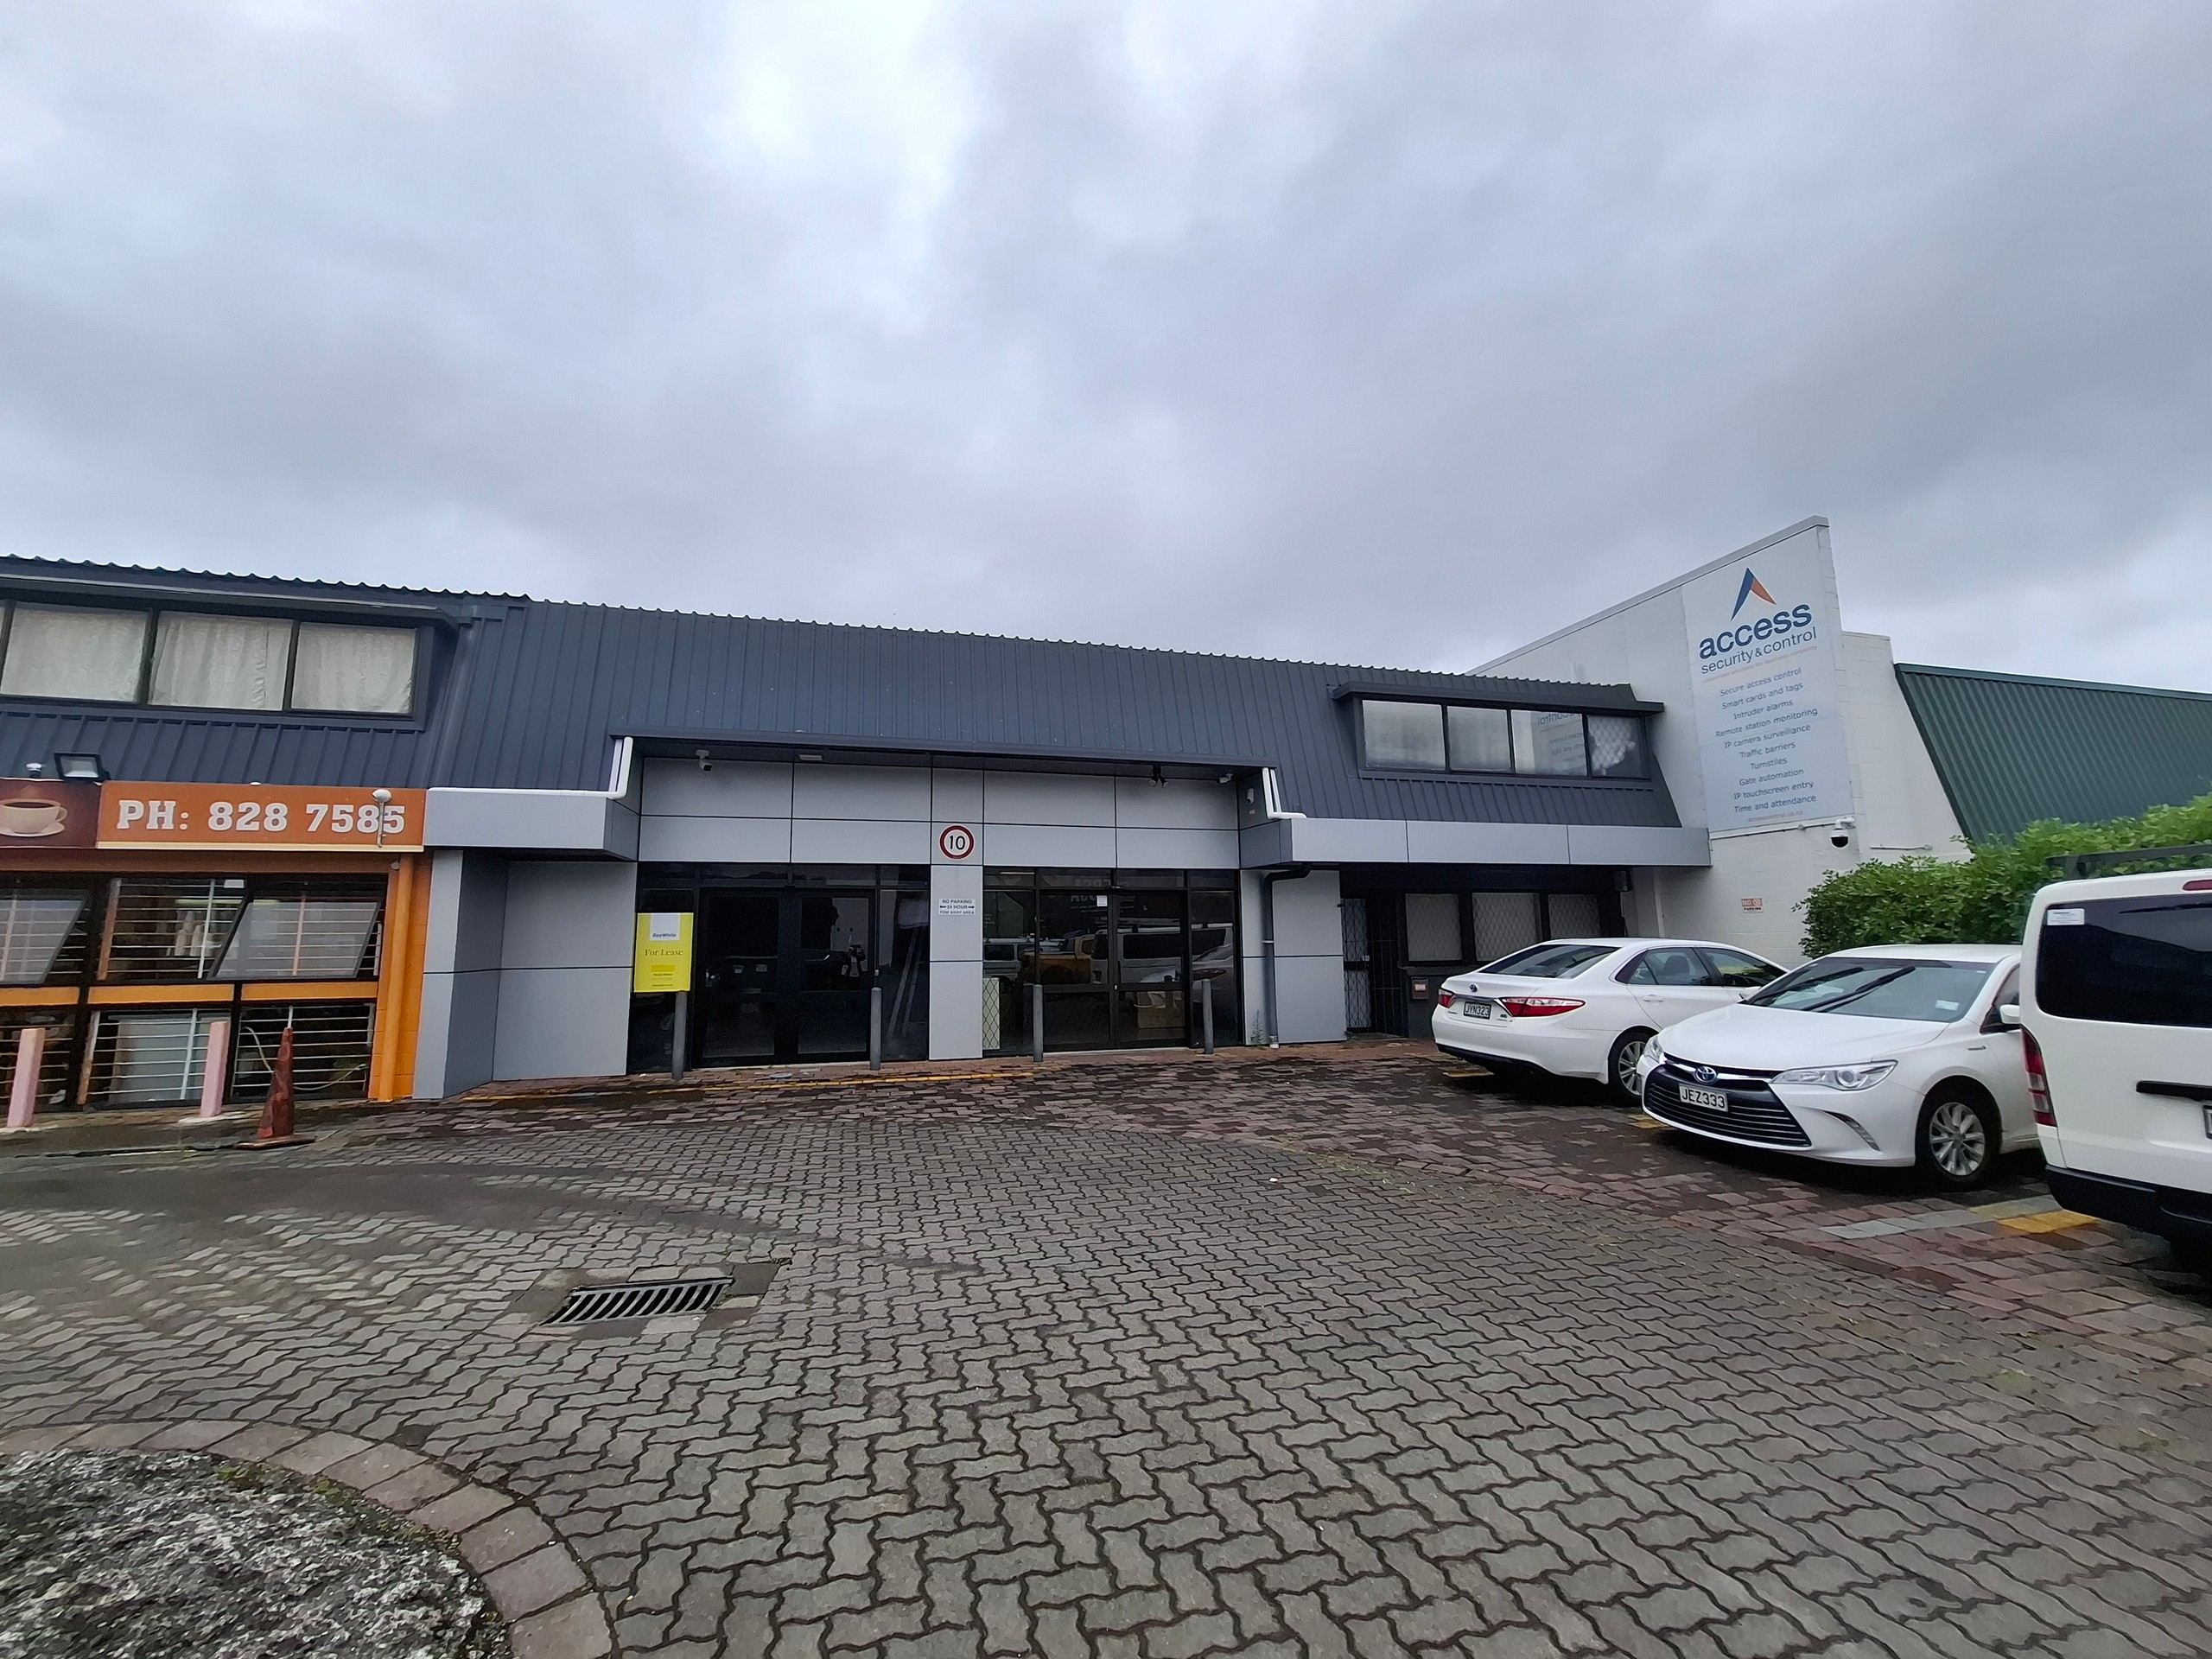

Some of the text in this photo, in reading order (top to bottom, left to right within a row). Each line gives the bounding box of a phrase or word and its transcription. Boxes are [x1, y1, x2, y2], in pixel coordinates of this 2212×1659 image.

[1699, 604, 1812, 659] access
[1701, 648, 1753, 674] security
[1764, 626, 1816, 654] control
[1719, 666, 1802, 696] Secure access control
[1721, 682, 1804, 710] Smart cards and tags
[1733, 699, 1794, 720] Intruder alarms
[1715, 708, 1818, 738] Remote station monitoring
[1733, 735, 1762, 747] camera
[1763, 723, 1811, 741] surveillance
[1739, 741, 1796, 759] Traffic barriers
[1750, 757, 1788, 770] Turnstiles
[1739, 768, 1804, 786] Gate automation
[1743, 785, 1789, 798] touchscreen
[1792, 780, 1814, 791] entry
[1734, 795, 1816, 813] Time and attendance
[116, 799, 406, 834] PH: 828 7585
[950, 835, 965, 850] 10
[1465, 1003, 1490, 1016] JYN323
[1681, 1089, 1726, 1109] JEZ333
